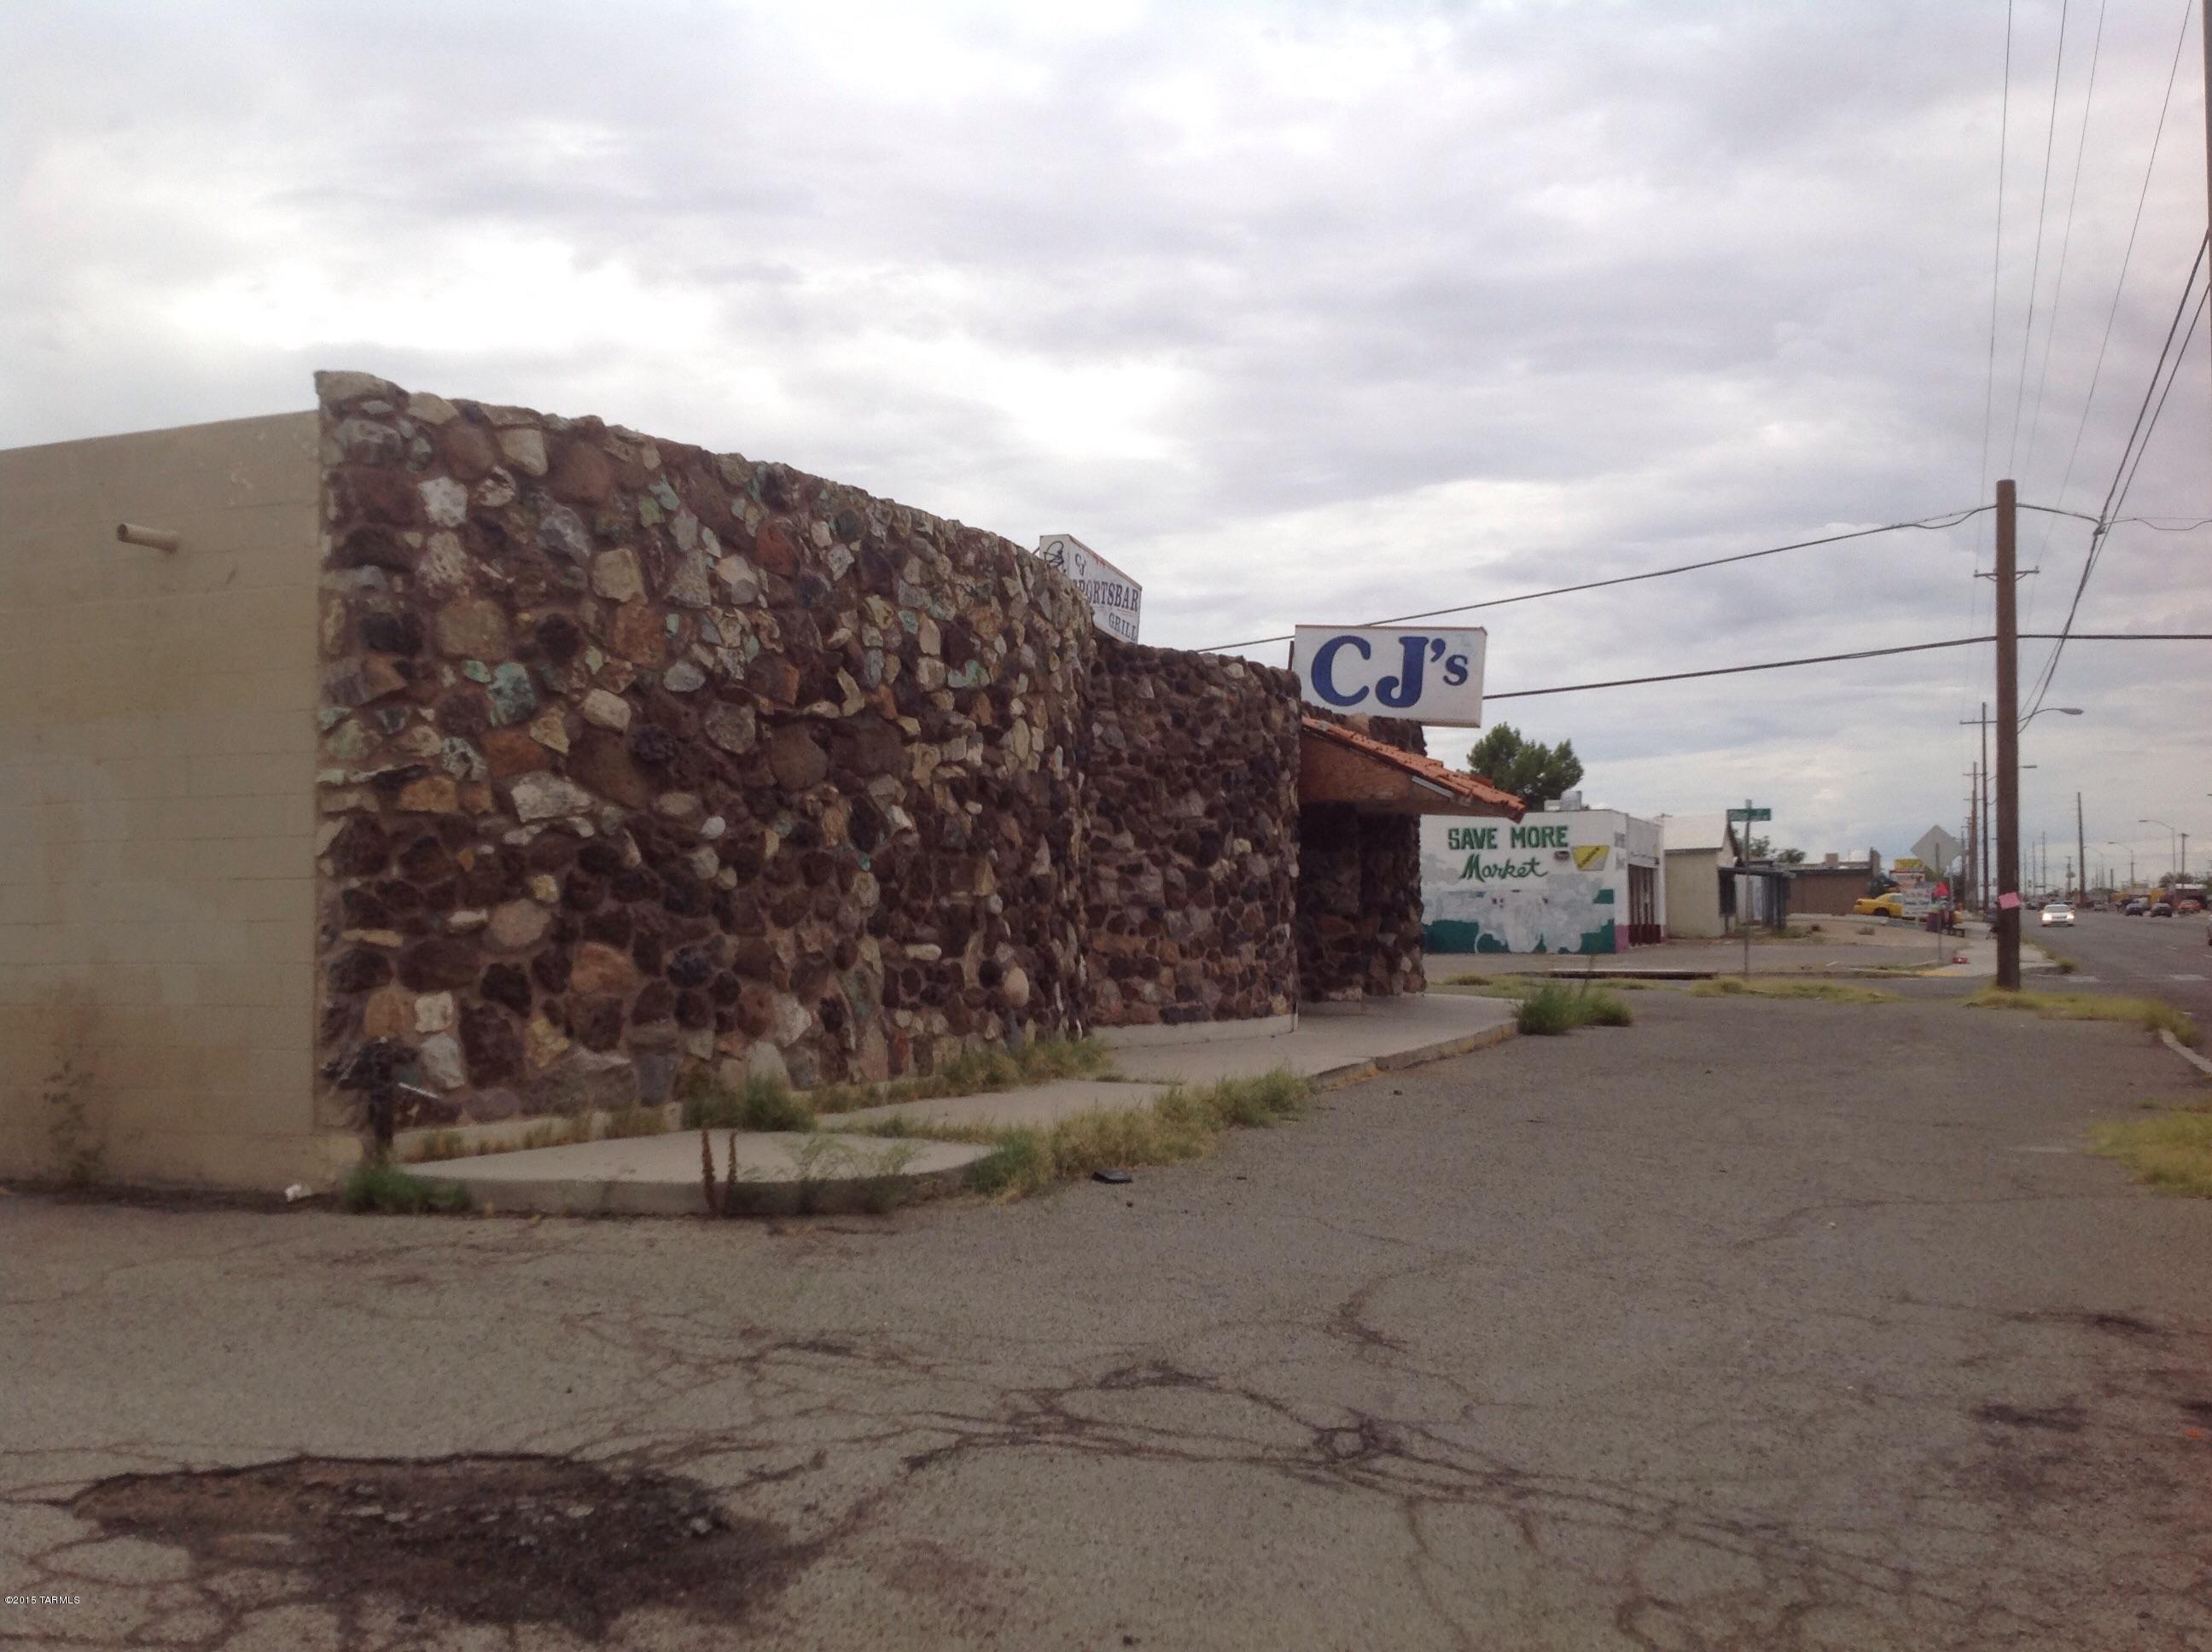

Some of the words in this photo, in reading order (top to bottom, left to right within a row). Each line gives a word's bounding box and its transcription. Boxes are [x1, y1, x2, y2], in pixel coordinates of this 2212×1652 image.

[1109, 612, 1137, 641] GRILL
[1311, 635, 1469, 708] CJ's
[1447, 828, 1497, 850] SAVE
[1511, 825, 1569, 848] MORE
[1459, 853, 1547, 882] Market
